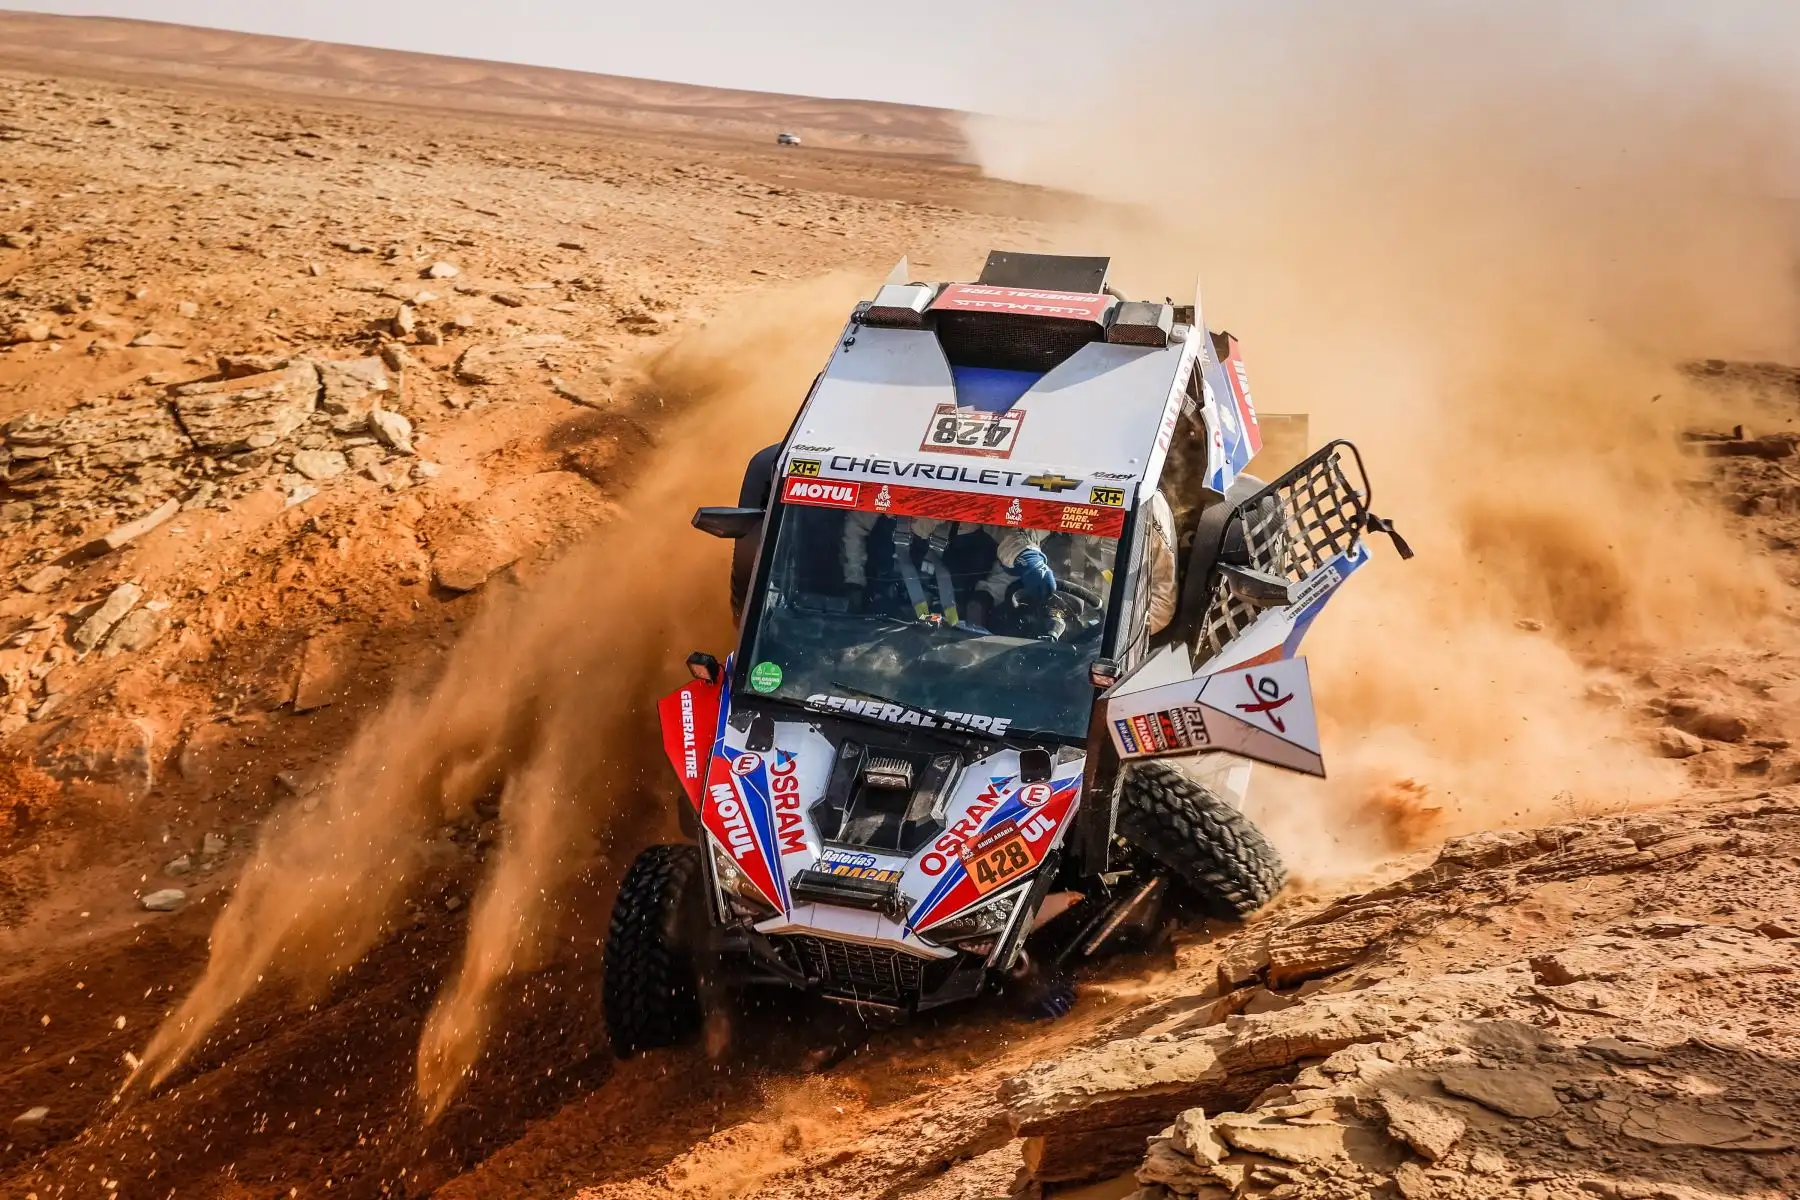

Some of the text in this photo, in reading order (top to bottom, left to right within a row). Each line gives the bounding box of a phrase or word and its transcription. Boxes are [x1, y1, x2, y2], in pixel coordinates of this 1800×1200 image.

[957, 287, 1005, 296] TIRE
[932, 417, 1012, 448] 428
[829, 455, 1023, 487] CHEVROLET
[789, 482, 854, 501] MOTUL
[1060, 520, 1094, 531] LIVE IT.
[1061, 514, 1090, 524] DARE.
[1062, 506, 1100, 517] DREAM.
[803, 693, 1013, 737] GENERAL TIRE
[680, 689, 698, 779] GENERAL TIRE
[1135, 717, 1156, 753] MOTUL
[769, 760, 809, 856] OSRAM
[1026, 786, 1045, 803] E
[709, 782, 756, 860] MOTUL
[977, 836, 994, 850] SAUDI
[994, 827, 1014, 843] ARABIA
[975, 840, 1030, 884] 428
